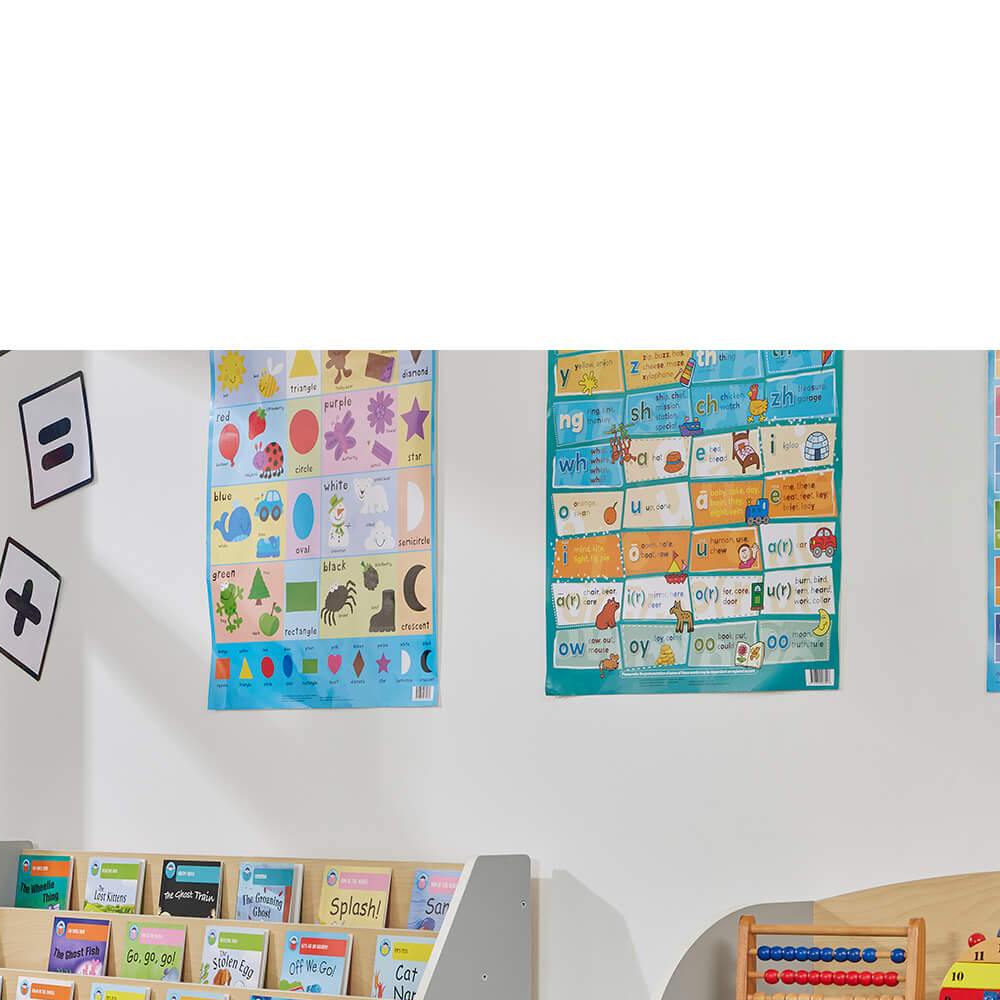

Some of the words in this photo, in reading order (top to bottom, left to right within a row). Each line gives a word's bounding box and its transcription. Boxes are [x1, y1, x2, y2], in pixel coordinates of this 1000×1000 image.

[402, 368, 429, 379] diamond
[560, 368, 570, 387] y
[290, 383, 317, 394] triangle
[770, 385, 794, 407] zh
[324, 397, 352, 412] purple
[631, 400, 651, 421] sh
[696, 394, 717, 415] ch
[216, 412, 230, 422] red
[559, 411, 584, 433] ng
[407, 452, 422, 462] star
[696, 447, 706, 461] e
[559, 451, 587, 473] wh
[295, 465, 313, 474] circle
[323, 480, 349, 491] white
[213, 491, 232, 502] blue
[398, 537, 431, 547] semicircle
[295, 545, 310, 554] oval
[323, 560, 346, 571] black
[212, 569, 236, 581] green
[767, 582, 792, 601] u(r)
[284, 627, 317, 637] rectangle
[400, 621, 430, 631] crescent
[558, 642, 585, 656] ow
[629, 640, 649, 658] oy
[694, 638, 715, 652] oo
[767, 635, 789, 649] oo
[94, 890, 105, 901] Lost
[105, 892, 128, 904] Kittens
[174, 891, 193, 899] Ghost
[194, 891, 215, 903] Train
[329, 896, 382, 920] Splash!
[53, 947, 65, 961] The
[65, 947, 84, 960] Ghost
[85, 945, 100, 957] Fish
[126, 950, 141, 963] Go,
[144, 951, 159, 966] go,
[161, 951, 176, 967] go!
[974, 951, 984, 961] 11
[213, 954, 238, 970] Stolen
[239, 960, 254, 980] Egg
[289, 958, 304, 976] Off
[305, 959, 318, 973] We
[319, 963, 337, 978] Go!
[395, 964, 418, 983] Cat
[951, 971, 964, 981] 10
